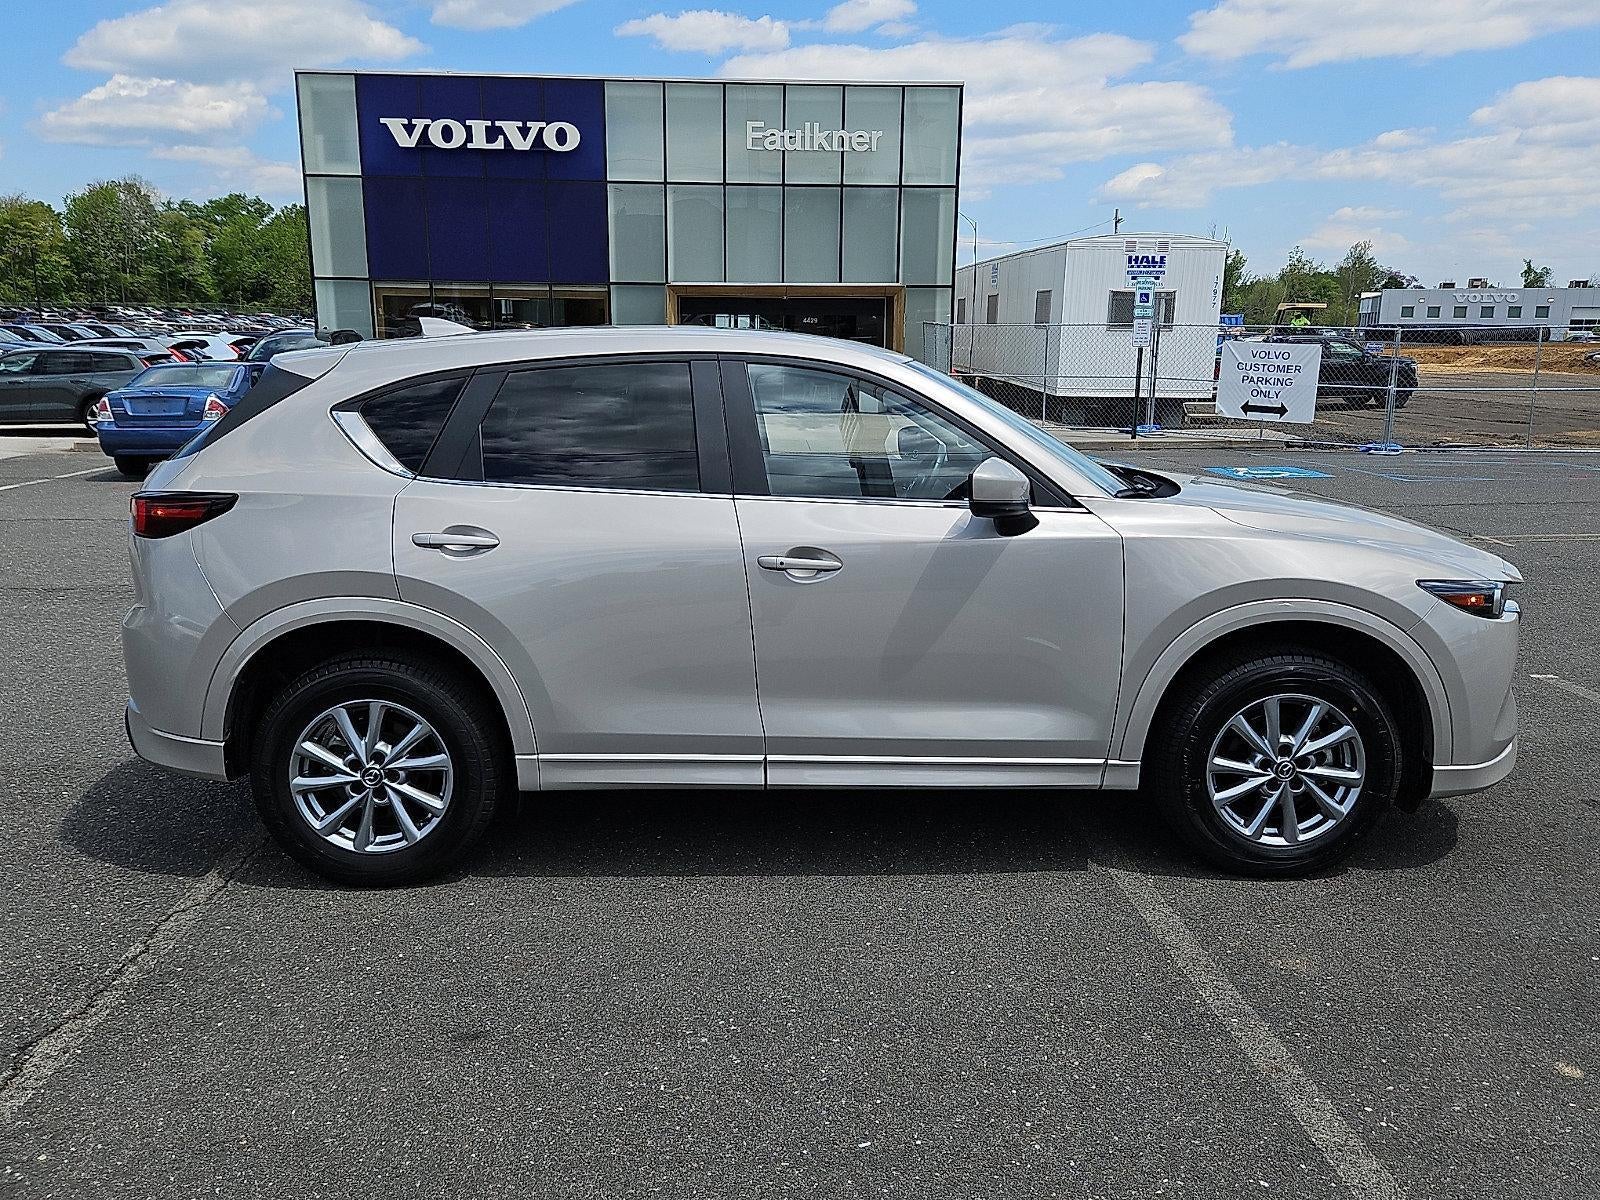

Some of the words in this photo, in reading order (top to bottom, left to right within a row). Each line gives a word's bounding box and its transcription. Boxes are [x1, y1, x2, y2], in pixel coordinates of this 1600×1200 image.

[379, 117, 581, 153] VOLVO
[745, 120, 884, 152] Faulkner
[1127, 255, 1167, 265] HALE
[1210, 275, 1219, 309] 17977
[1453, 292, 1520, 303] VOLVO
[1250, 349, 1292, 361] VOLVO
[1236, 361, 1302, 374] CUSTOMER
[1241, 374, 1294, 387] PARKING
[1250, 388, 1282, 399] ONLY
